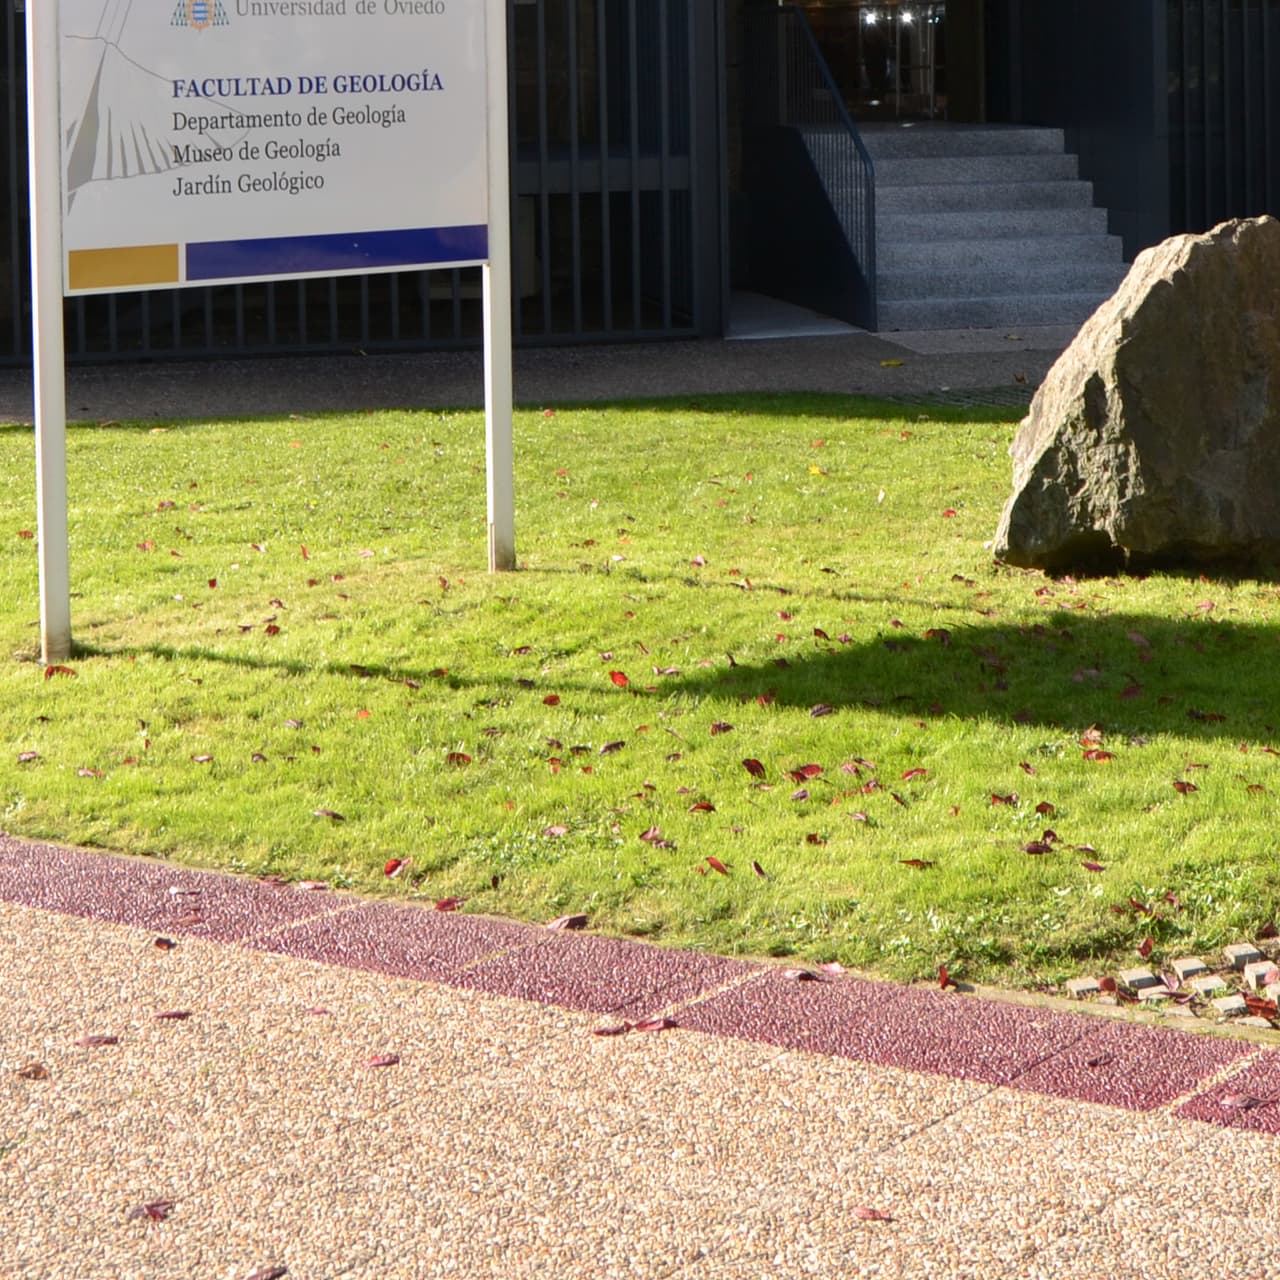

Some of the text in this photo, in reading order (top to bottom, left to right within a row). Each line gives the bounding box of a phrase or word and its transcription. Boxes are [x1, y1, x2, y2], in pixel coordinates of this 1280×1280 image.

[171, 68, 444, 98] FACULTAD DE GEOLOGÍA
[172, 104, 406, 135] Departamento de Geología
[172, 138, 341, 164] Museo de Geología
[172, 170, 325, 197] Jardín Geológico
